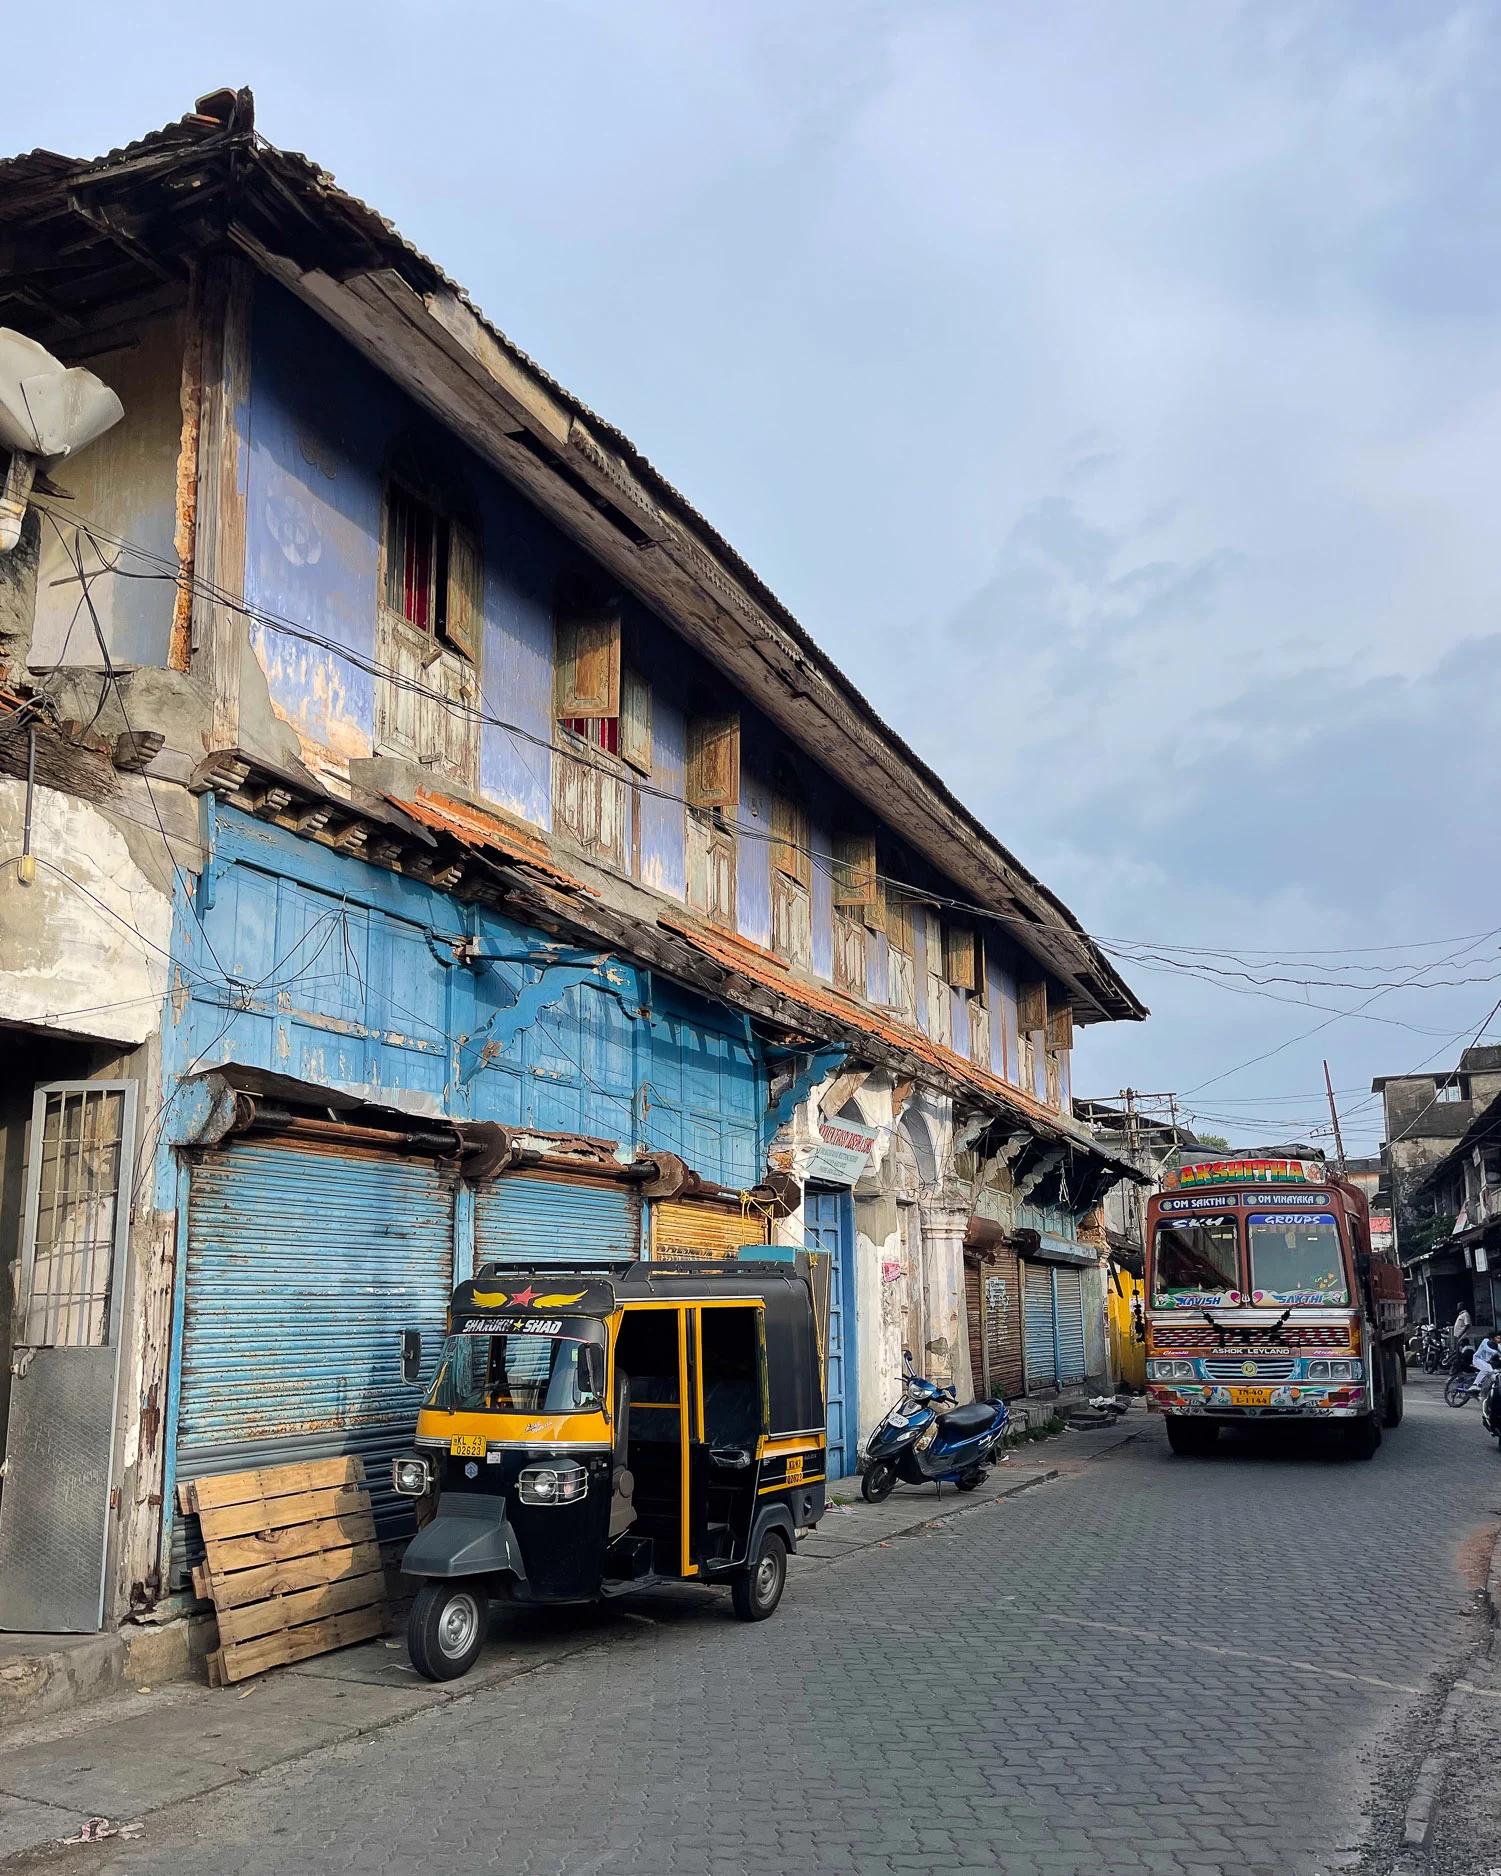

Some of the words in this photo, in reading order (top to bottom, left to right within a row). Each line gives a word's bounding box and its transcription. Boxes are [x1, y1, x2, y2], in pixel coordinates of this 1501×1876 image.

[1180, 1159, 1306, 1188] AKSHITHA
[1191, 1197, 1226, 1208] SAKTHI
[1258, 1195, 1271, 1204] OM
[1273, 1195, 1314, 1204] VINAYAKA
[1265, 1216, 1320, 1225] GROUPS
[1277, 1294, 1323, 1304] SAKTHI
[522, 1320, 562, 1334] SHAD
[457, 1436, 467, 1445] KL
[472, 1436, 482, 1446] 43
[456, 1446, 481, 1455] 02623
